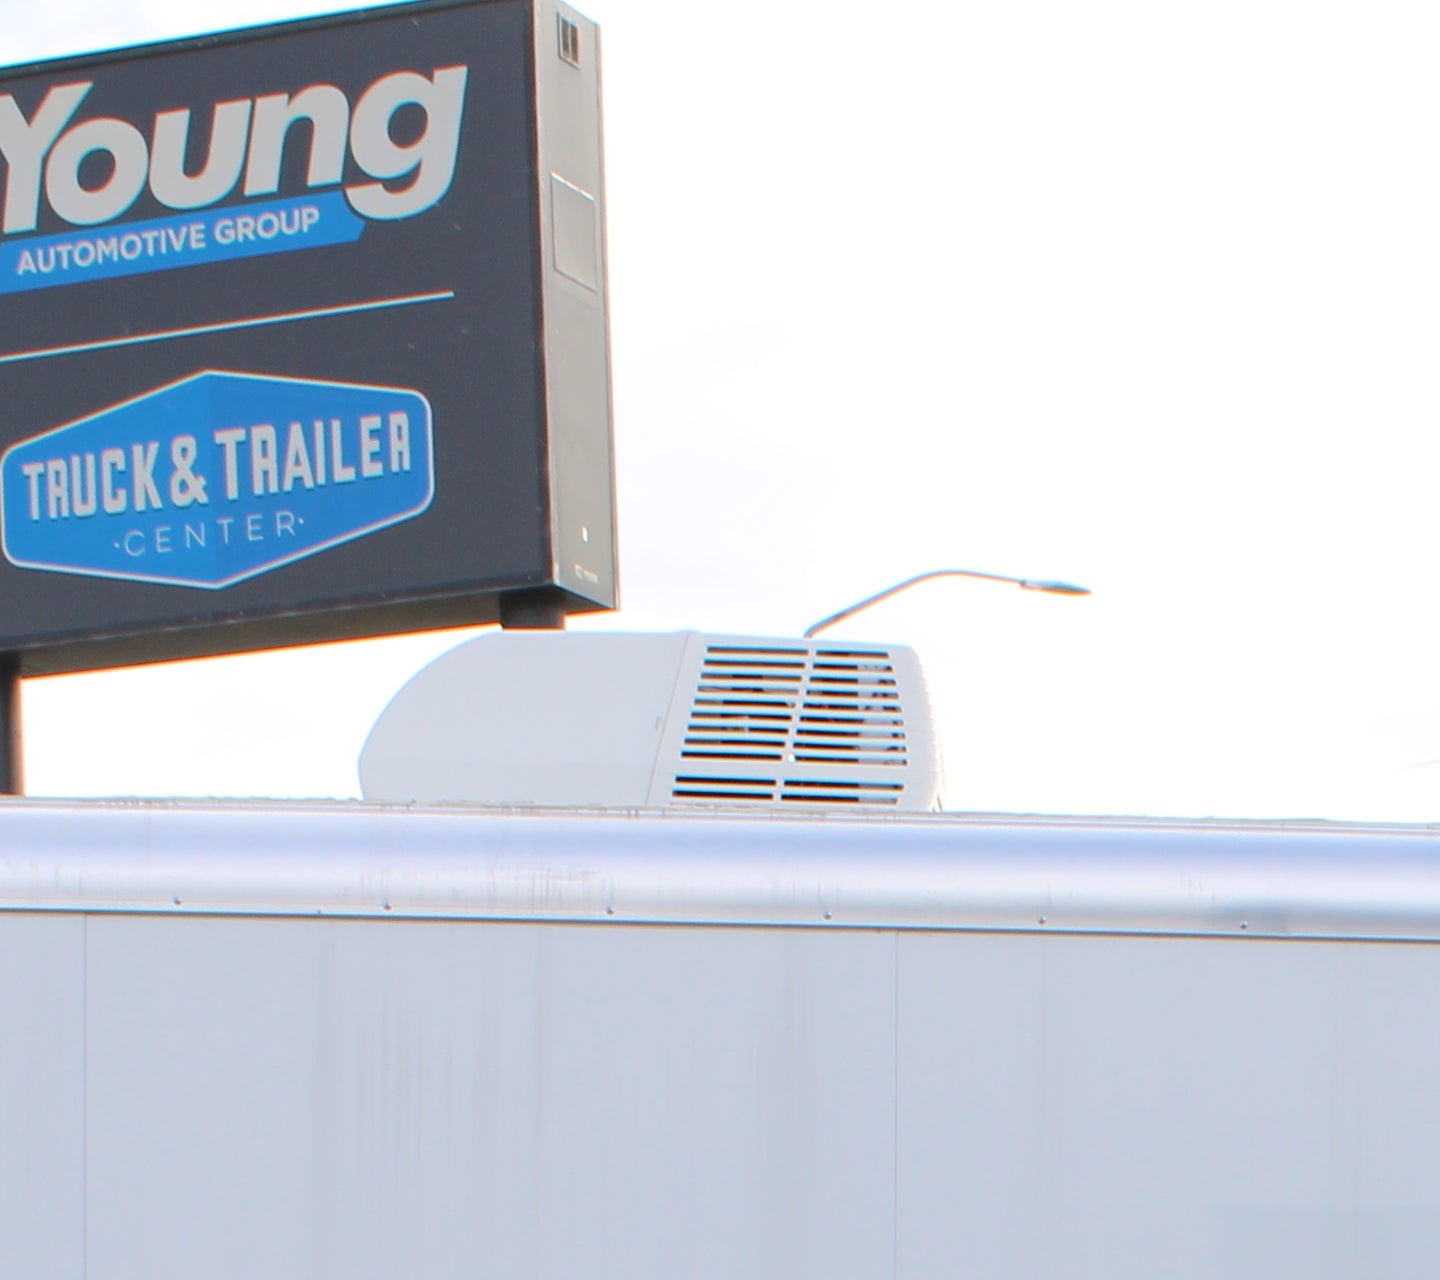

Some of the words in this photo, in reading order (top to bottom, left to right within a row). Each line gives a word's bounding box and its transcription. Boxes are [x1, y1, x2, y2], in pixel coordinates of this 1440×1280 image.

[16, 222, 207, 275] AUTOMOTIVE
[214, 206, 320, 246] GROUP
[22, 441, 163, 521] TRUCK
[170, 435, 209, 507] &
[214, 411, 412, 501] TRAILER
